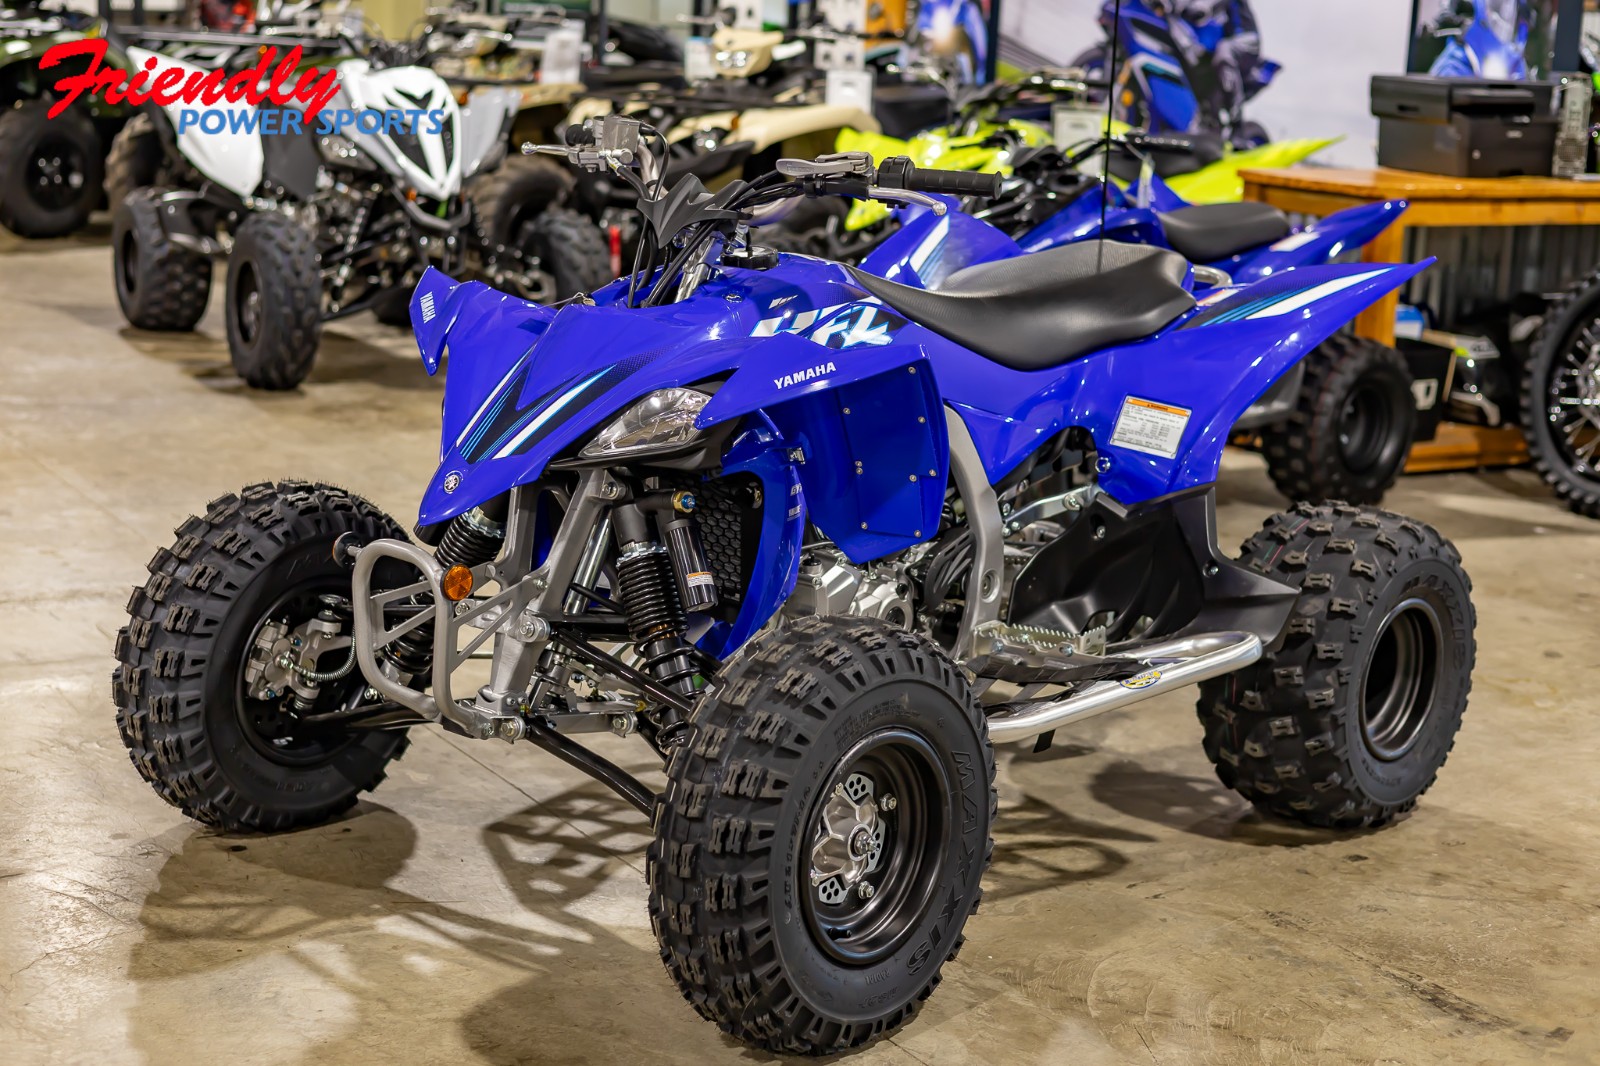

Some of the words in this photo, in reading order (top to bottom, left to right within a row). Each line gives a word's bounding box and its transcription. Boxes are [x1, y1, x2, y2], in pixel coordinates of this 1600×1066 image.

[419, 290, 437, 324] YAMAHA
[773, 361, 837, 390] YAMAHA
[907, 750, 978, 977] MAXXIS
